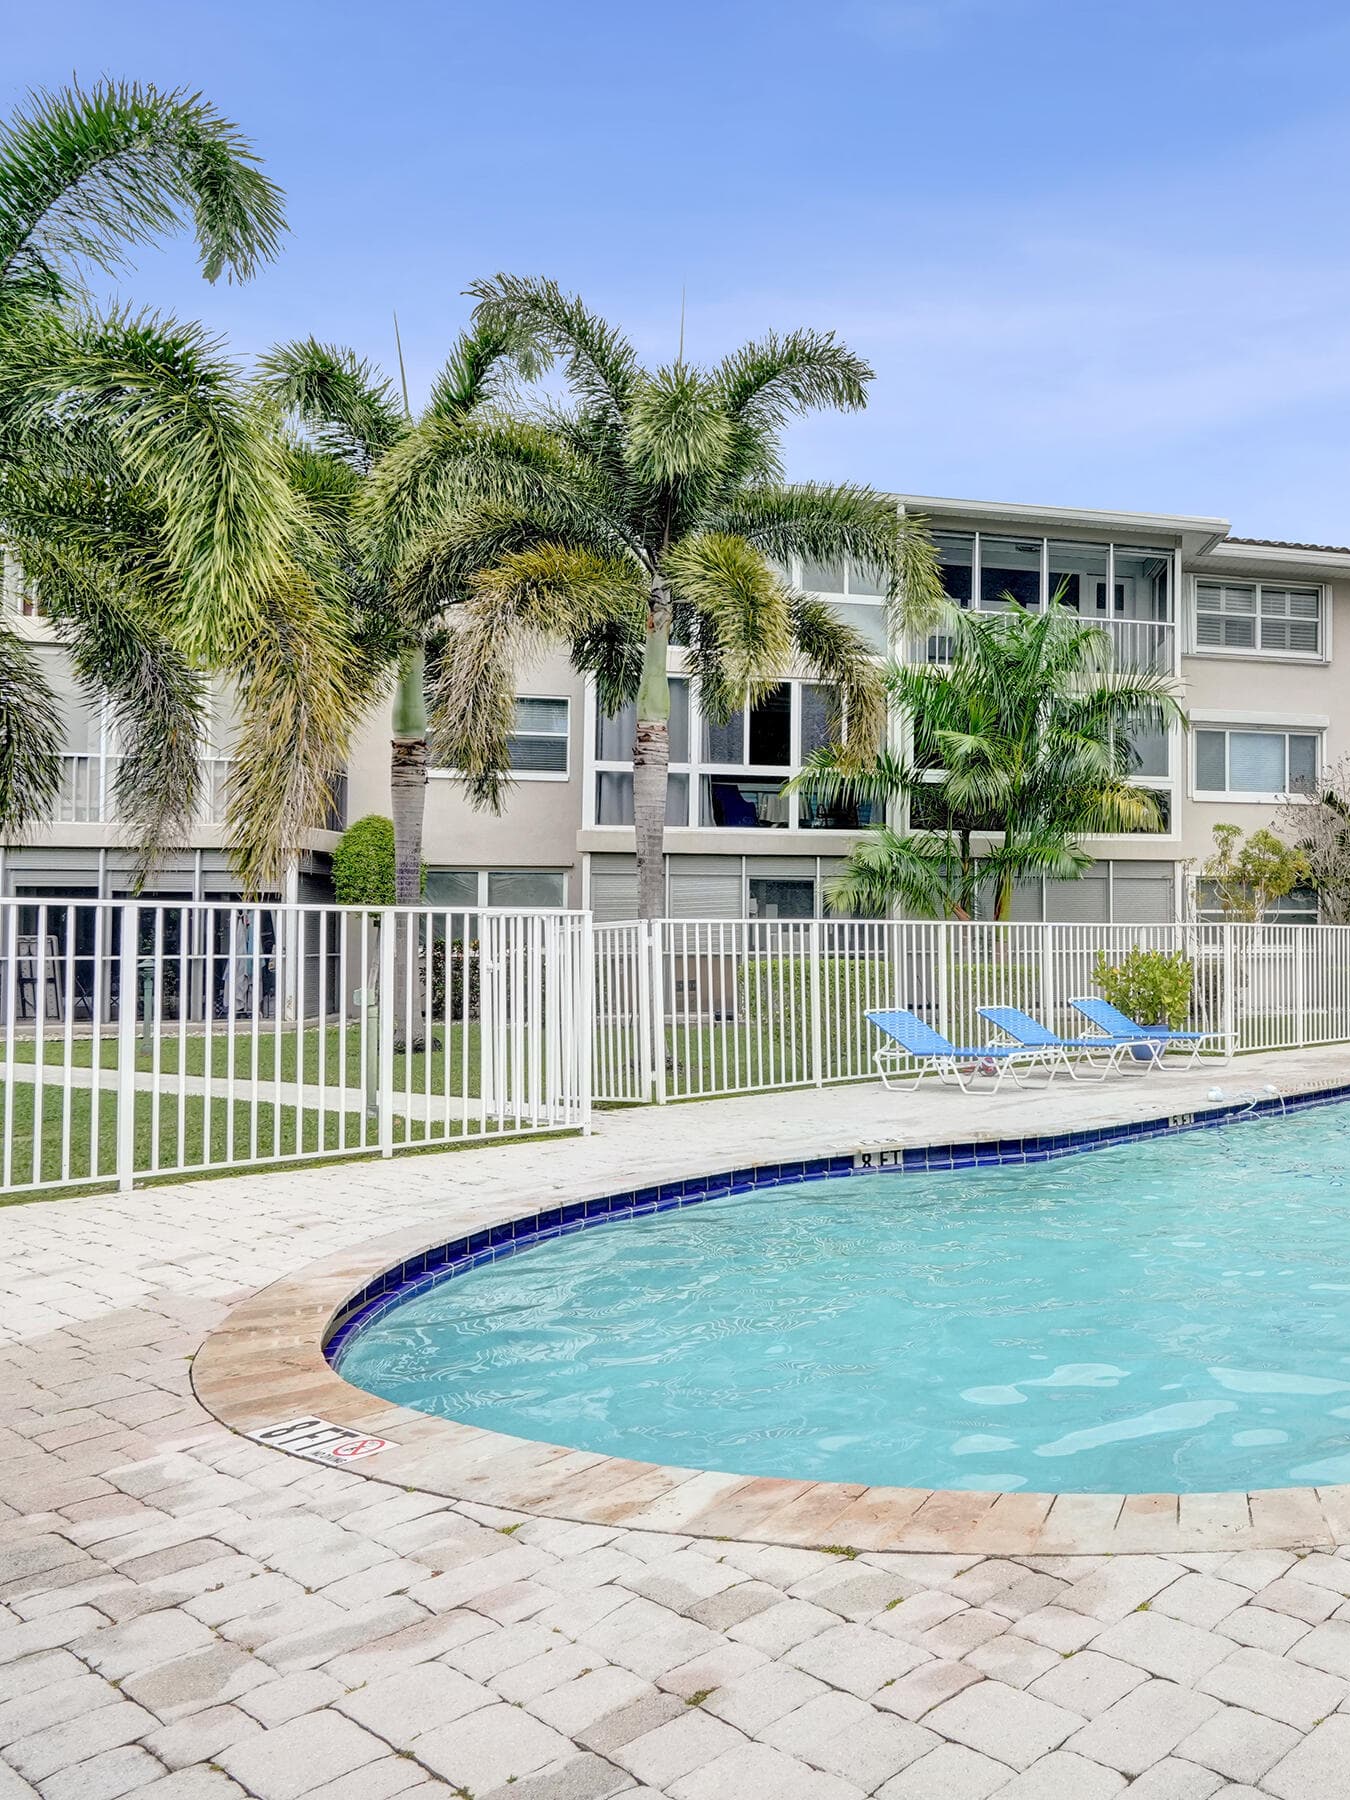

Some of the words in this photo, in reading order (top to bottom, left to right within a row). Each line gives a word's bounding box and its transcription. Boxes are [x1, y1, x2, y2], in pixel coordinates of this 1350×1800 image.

[861, 1153, 872, 1168] 8
[880, 1150, 901, 1167] FT
[259, 1420, 321, 1439] 8
[277, 1426, 360, 1452] FT
